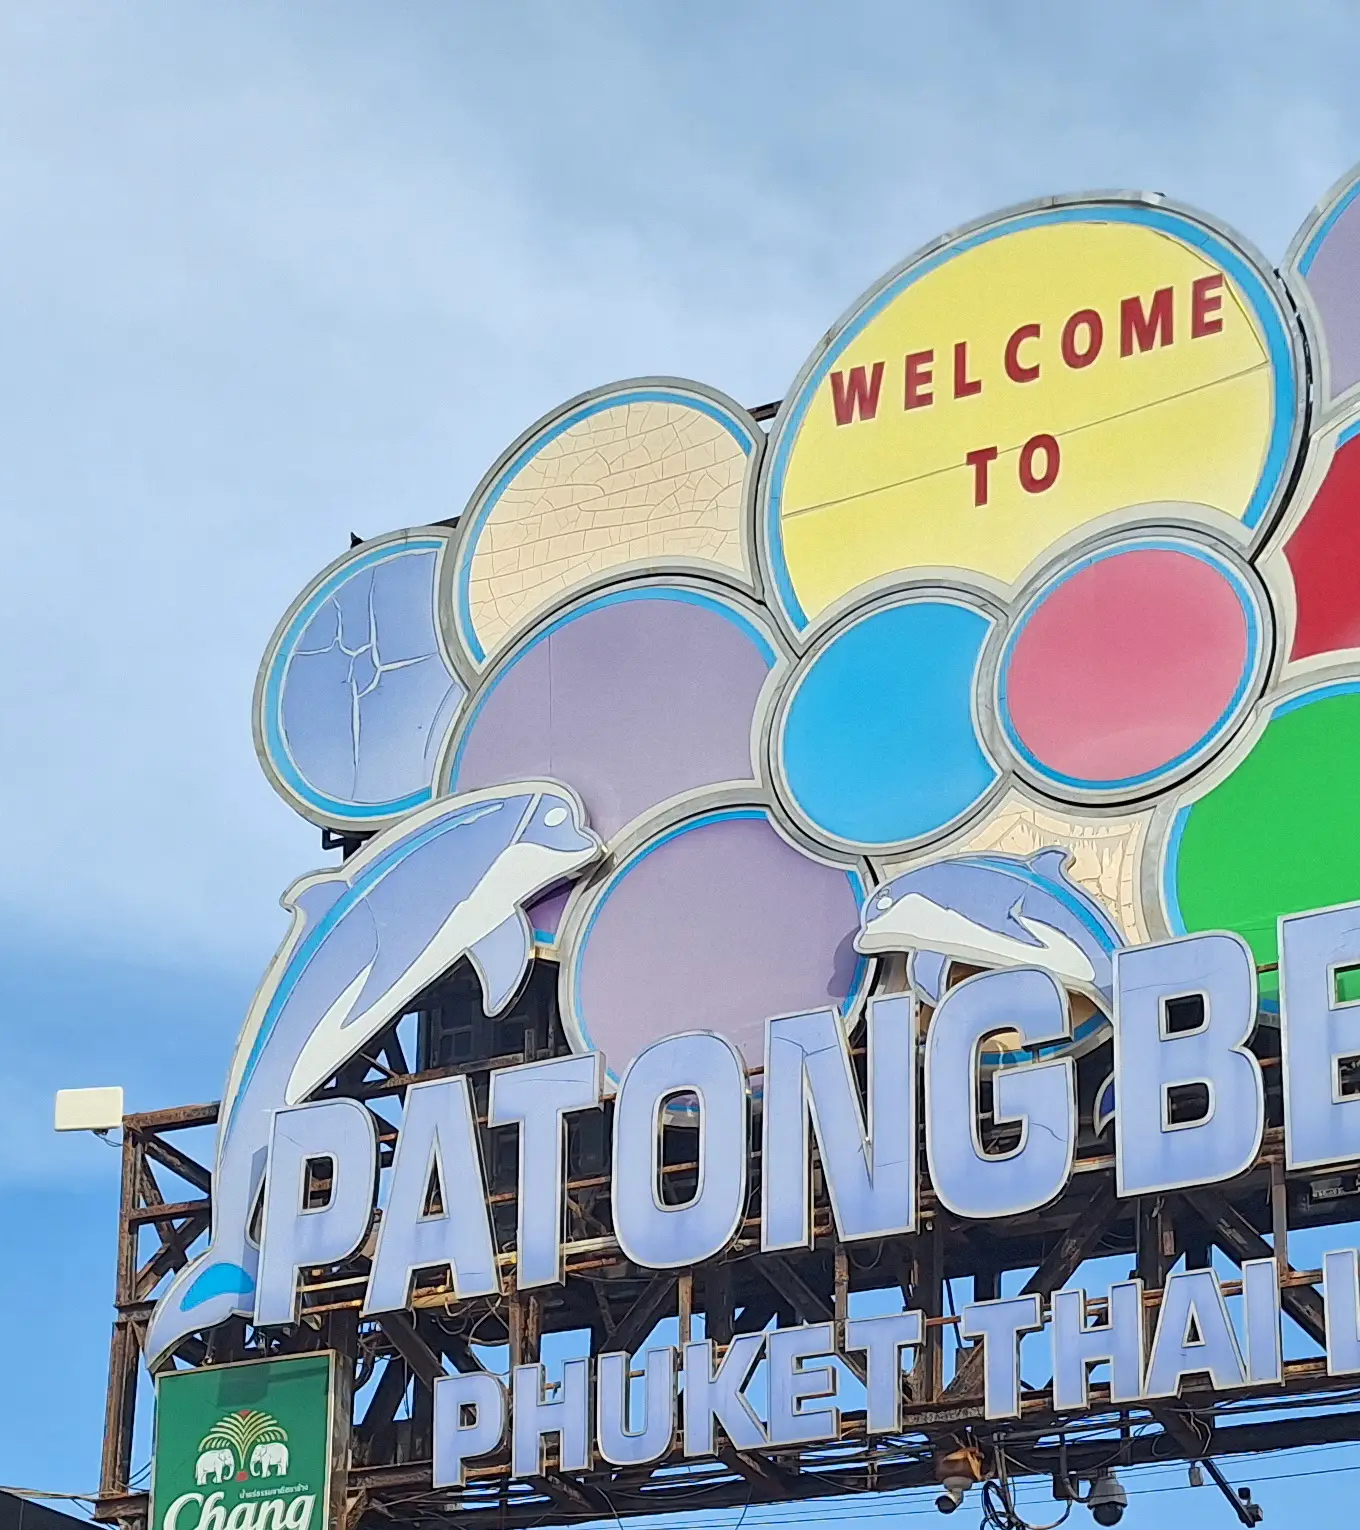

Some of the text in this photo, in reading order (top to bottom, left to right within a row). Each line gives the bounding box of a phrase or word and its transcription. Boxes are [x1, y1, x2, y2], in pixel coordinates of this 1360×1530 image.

[830, 274, 1223, 427] WELCOME
[966, 433, 1060, 508] TO
[254, 964, 1077, 1327] PATONG
[433, 1309, 925, 1489] PHUKET
